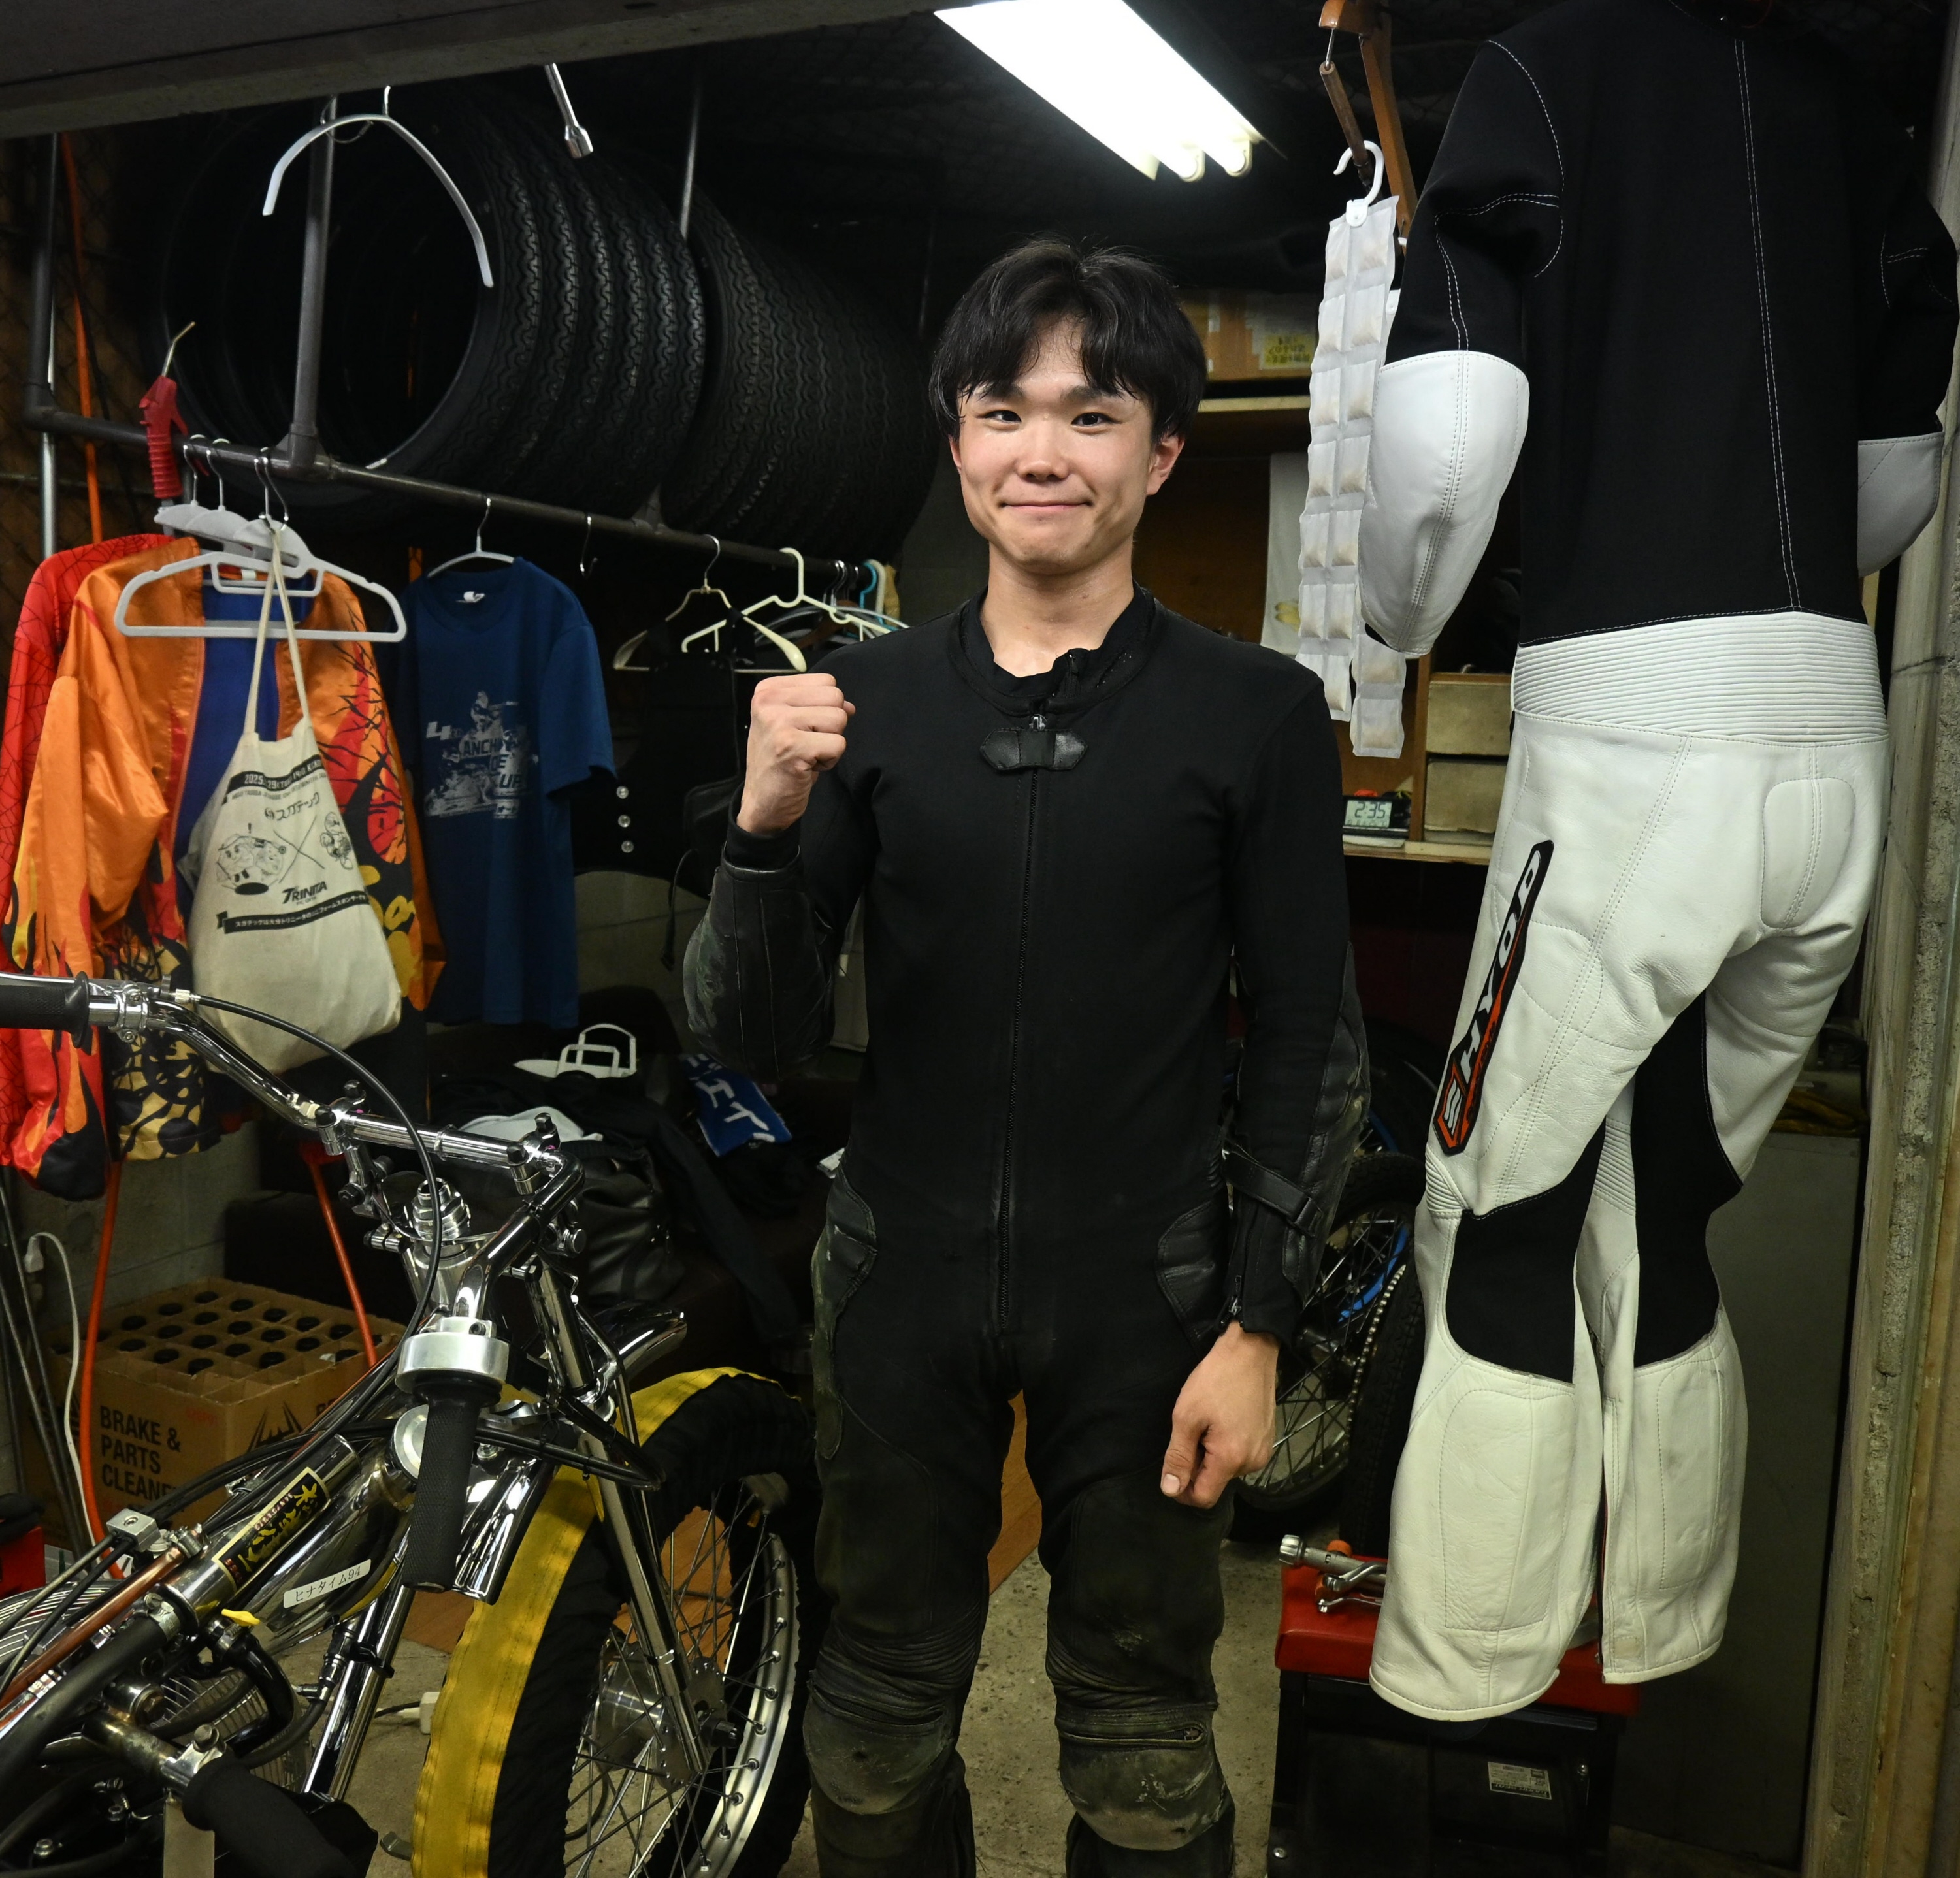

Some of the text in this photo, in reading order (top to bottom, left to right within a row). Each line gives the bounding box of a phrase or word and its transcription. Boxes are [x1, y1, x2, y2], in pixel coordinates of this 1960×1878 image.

[1354, 801, 1386, 819] 2:35
[282, 881, 328, 905] TRINITA
[1460, 849, 1542, 1084] HYOD
[100, 1405, 162, 1446] BRAKE
[167, 1427, 182, 1453] &
[101, 1434, 161, 1475] PARTS
[102, 1463, 174, 1502] CLEANE
[295, 1566, 361, 1602] ヒナタイム94
